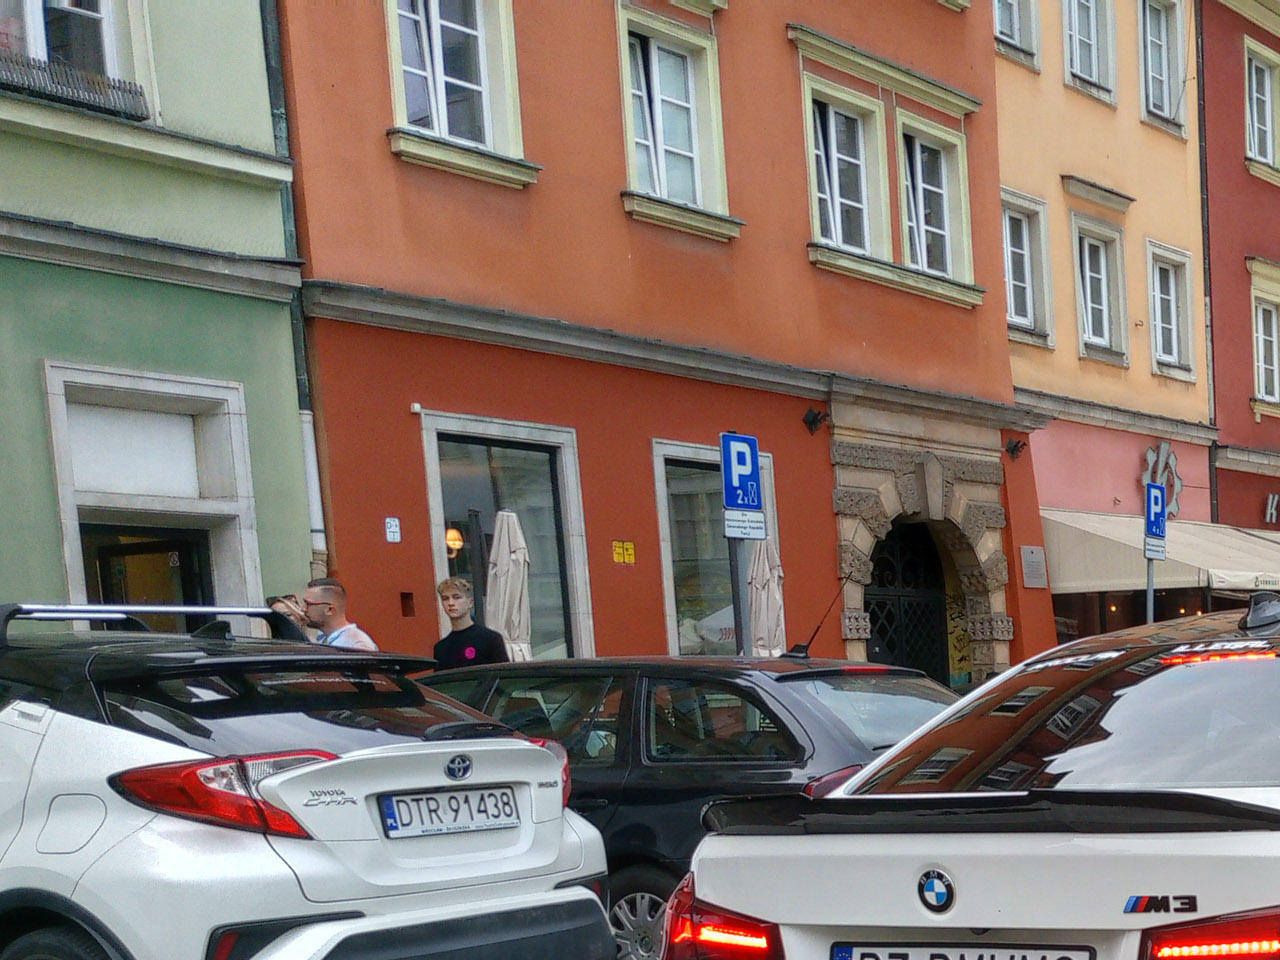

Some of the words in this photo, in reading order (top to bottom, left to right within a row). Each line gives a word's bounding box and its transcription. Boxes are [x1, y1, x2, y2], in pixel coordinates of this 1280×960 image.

[730, 441, 752, 488] P
[1150, 488, 1162, 521] P
[1171, 639, 1272, 654] ILLEGAL
[303, 797, 358, 807] C-HR
[396, 795, 444, 828] DTR
[447, 791, 514, 823] 91438
[387, 818, 397, 827] PL
[1149, 895, 1198, 913] M3
